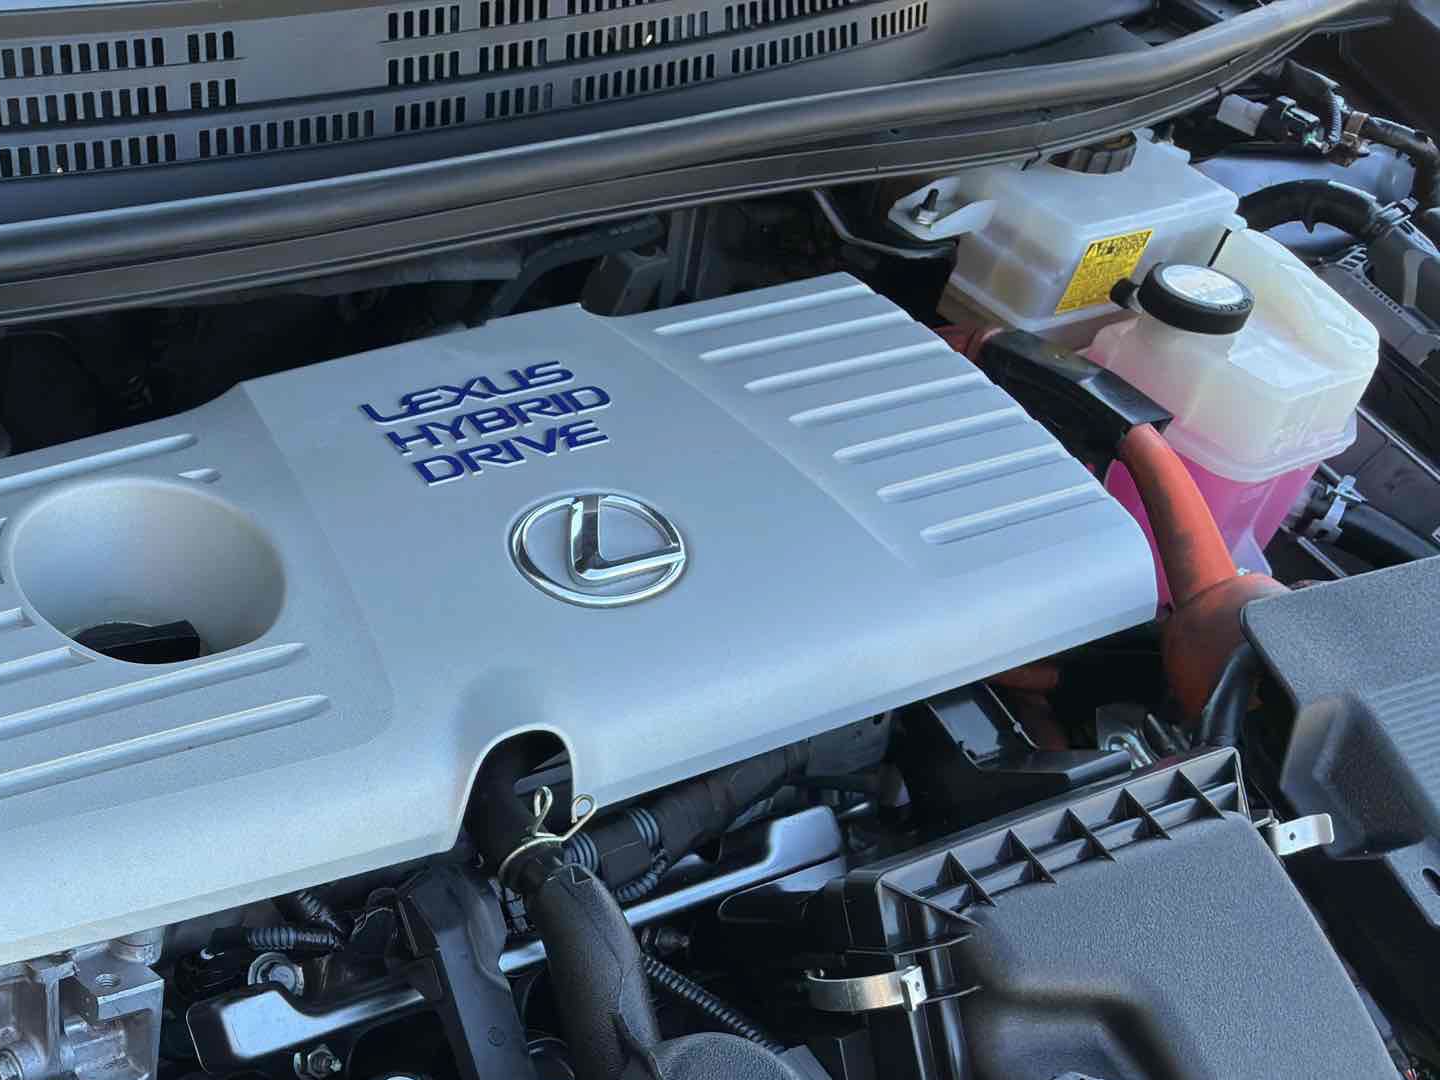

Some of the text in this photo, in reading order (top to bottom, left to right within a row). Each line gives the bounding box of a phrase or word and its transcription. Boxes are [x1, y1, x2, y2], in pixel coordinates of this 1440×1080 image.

[359, 361, 575, 425] LEXUS
[386, 386, 611, 456] HYBRID
[413, 420, 610, 486] DRIVE
